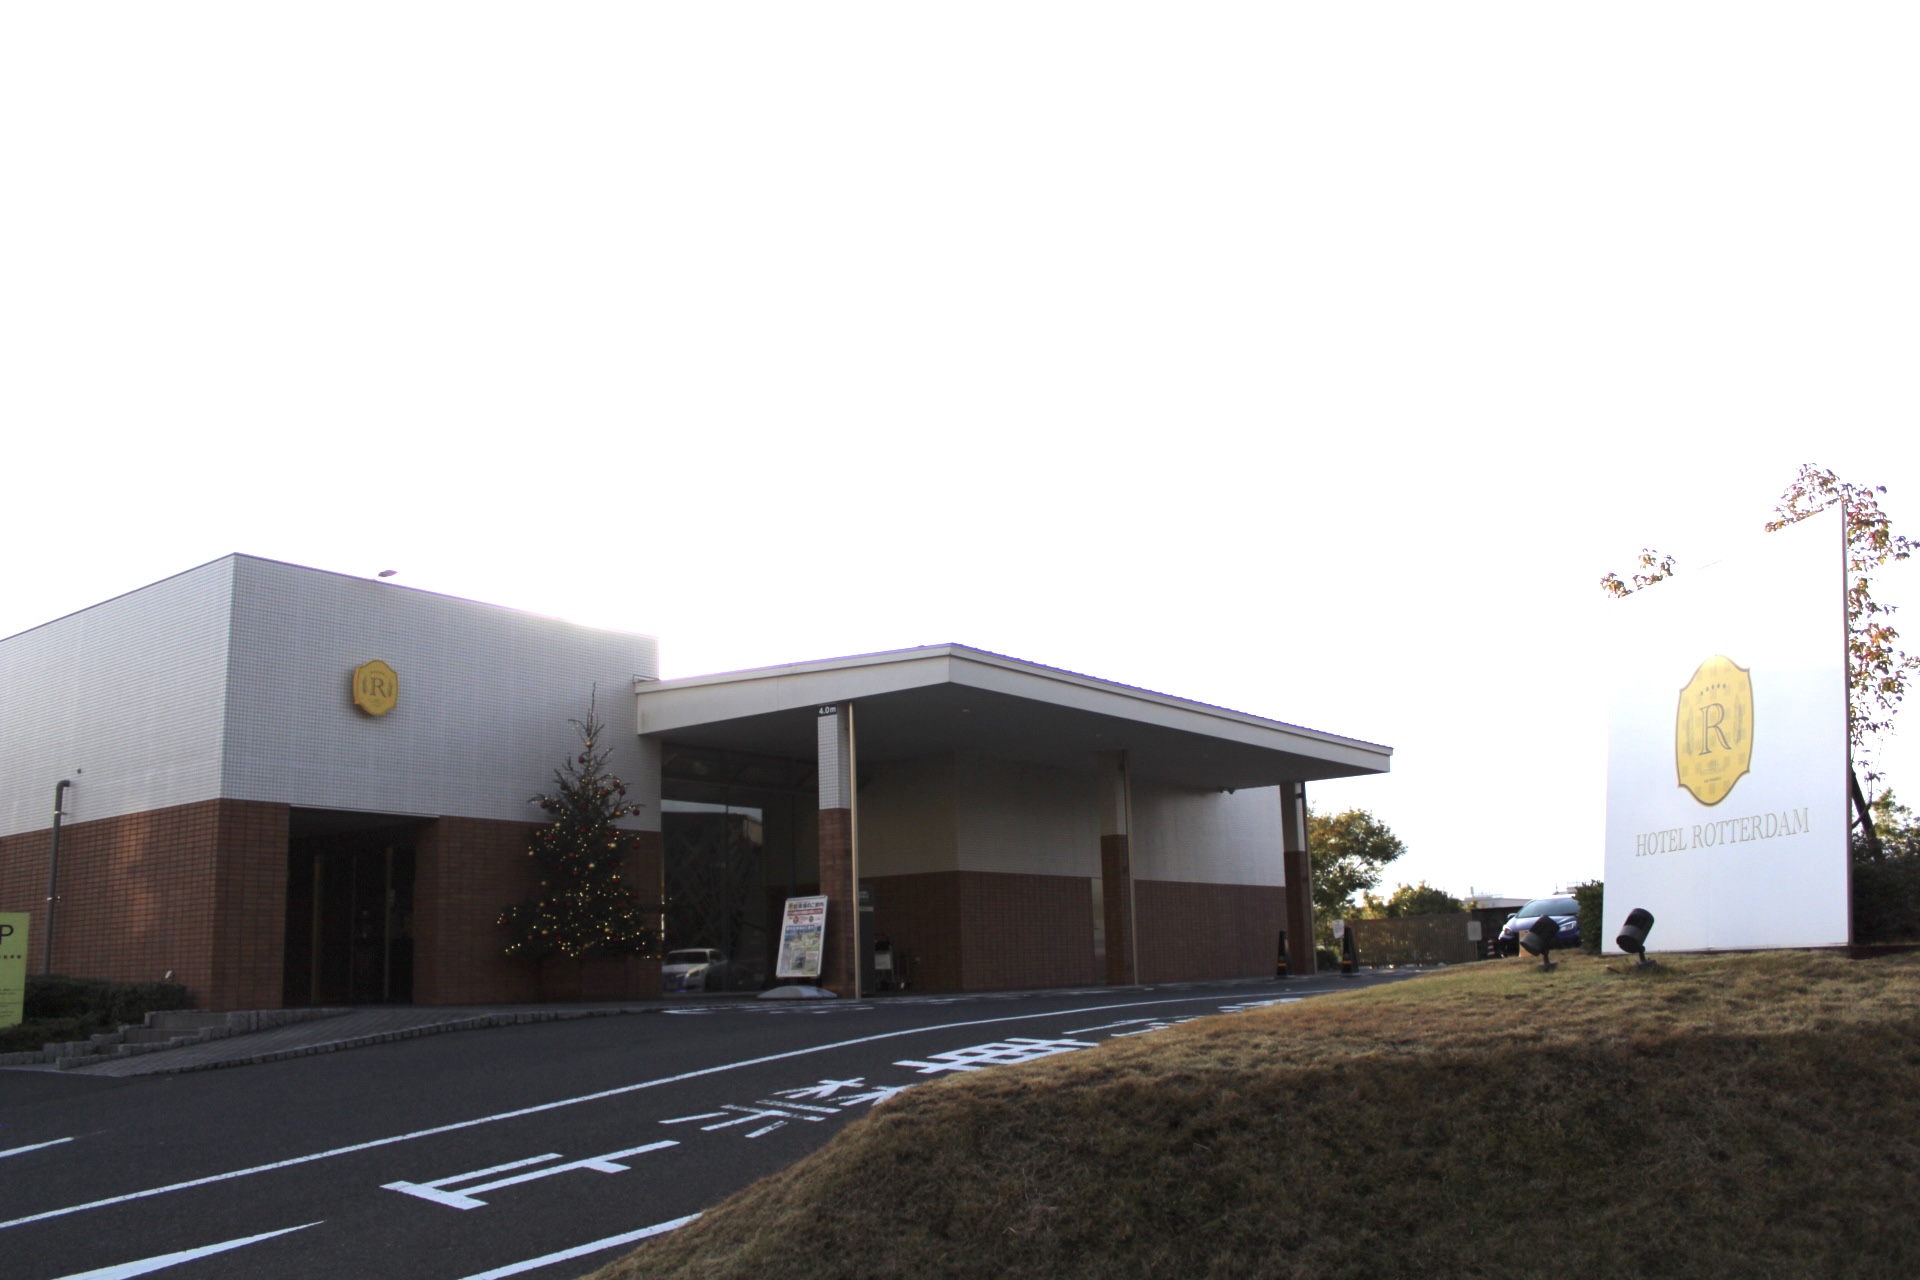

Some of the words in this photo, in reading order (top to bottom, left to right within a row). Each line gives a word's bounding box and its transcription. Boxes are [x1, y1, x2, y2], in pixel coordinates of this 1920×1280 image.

[370, 678, 386, 697] R
[818, 706, 837, 715] 4.0m
[1699, 703, 1732, 755] R
[1636, 829, 1686, 857] HOTEL
[1692, 808, 1809, 848] ROTTERDAM
